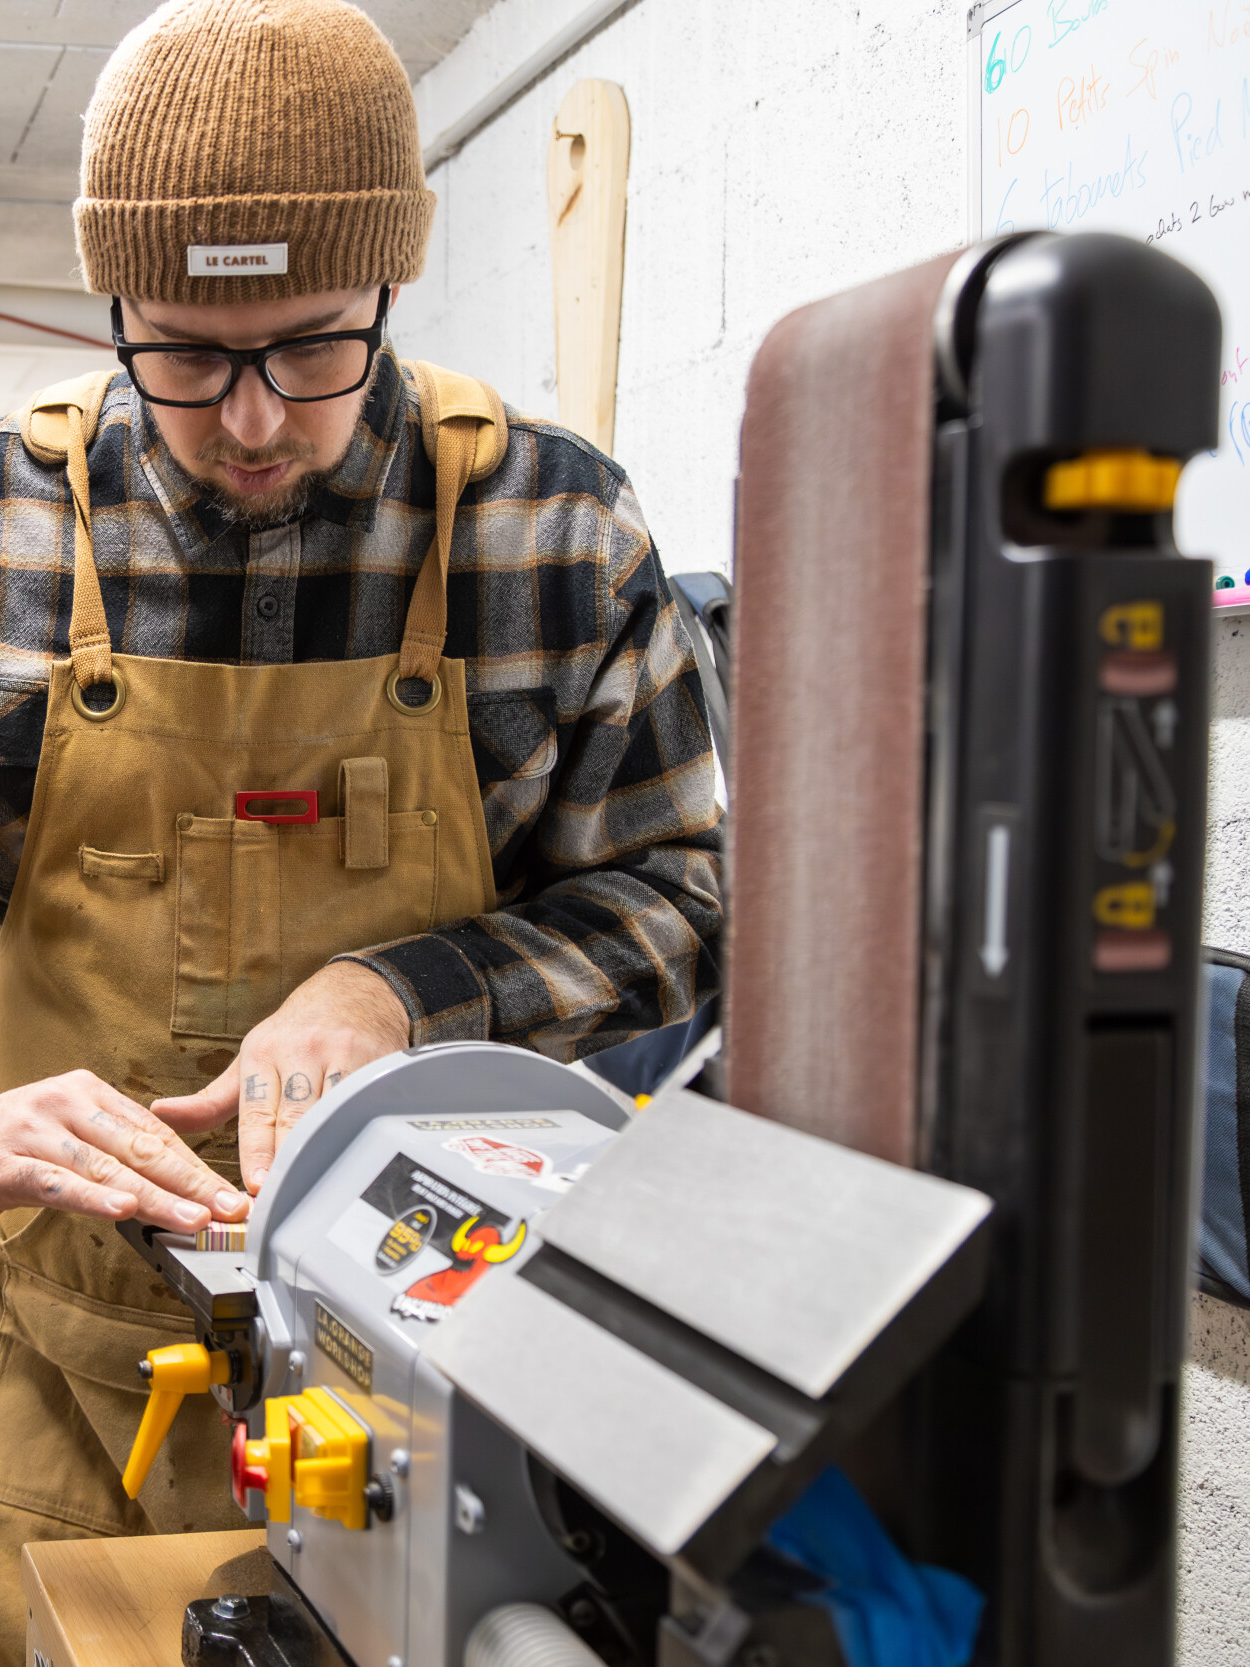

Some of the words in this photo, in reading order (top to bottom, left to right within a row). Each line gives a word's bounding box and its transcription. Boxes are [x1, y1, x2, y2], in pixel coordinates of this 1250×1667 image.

[997, 108, 1030, 168] 10
[1189, 201, 1202, 224] 2
[206, 256, 218, 267] LE
[223, 256, 268, 267] CARTEL
